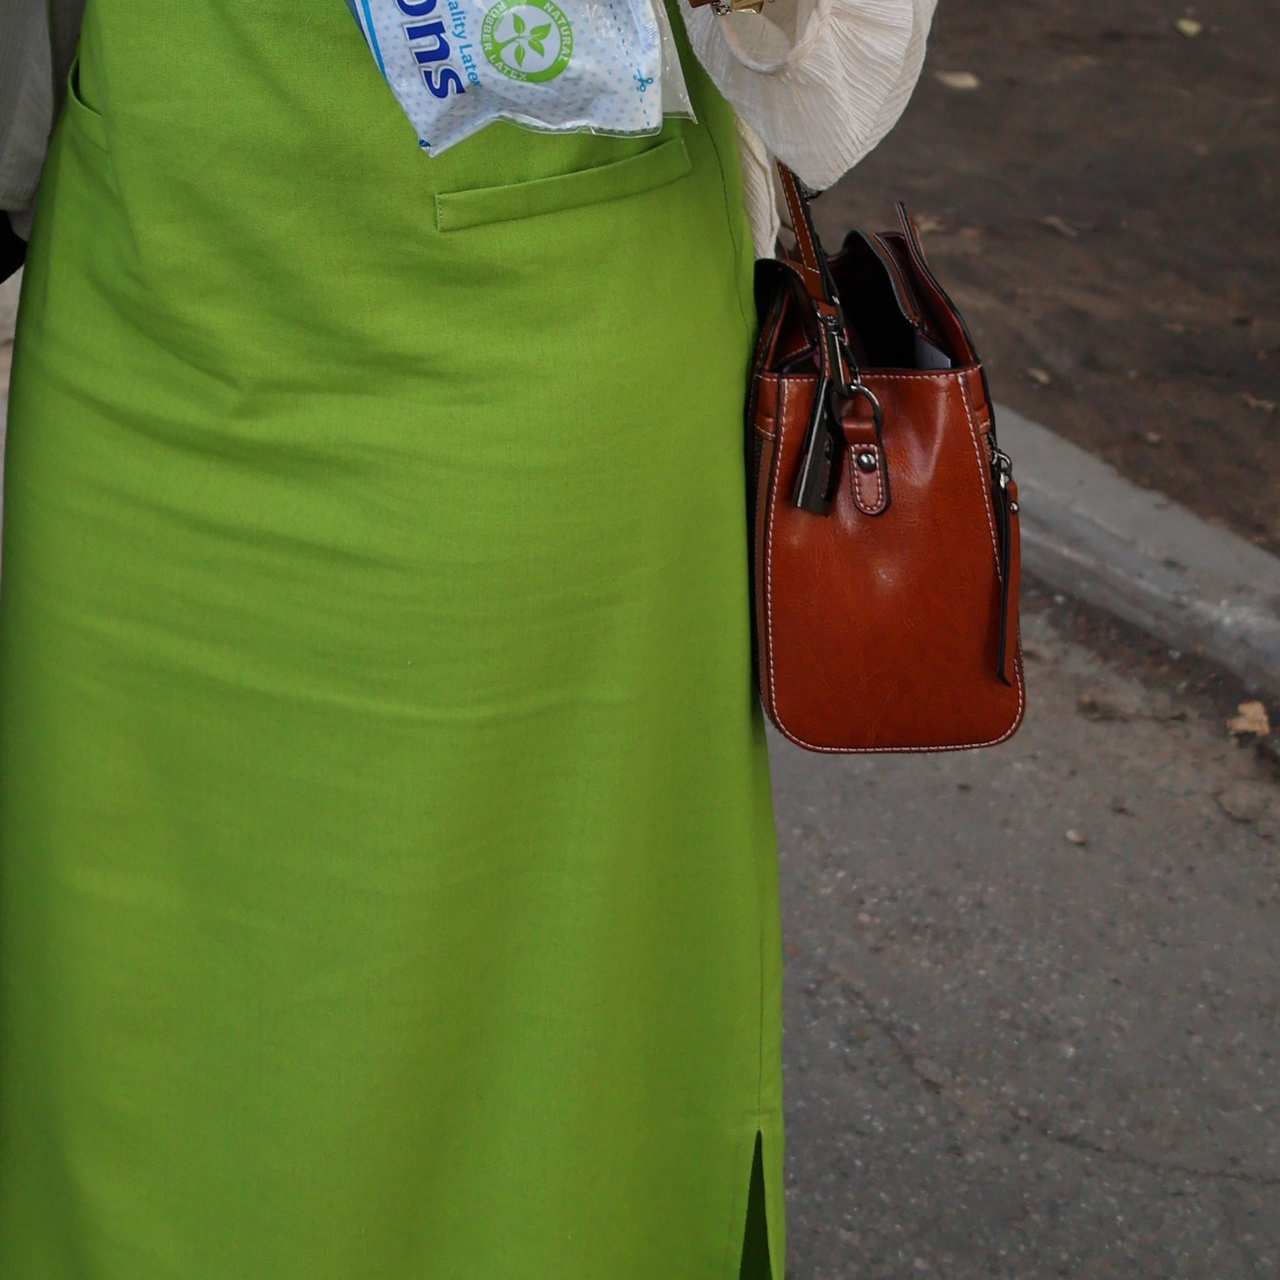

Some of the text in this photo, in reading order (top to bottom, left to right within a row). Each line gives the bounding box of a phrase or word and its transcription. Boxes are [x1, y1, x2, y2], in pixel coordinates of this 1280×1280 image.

[482, 1, 528, 81] RUBBER LATEX
[543, 1, 572, 61] NATURAL
[458, 43, 483, 88] Latex
